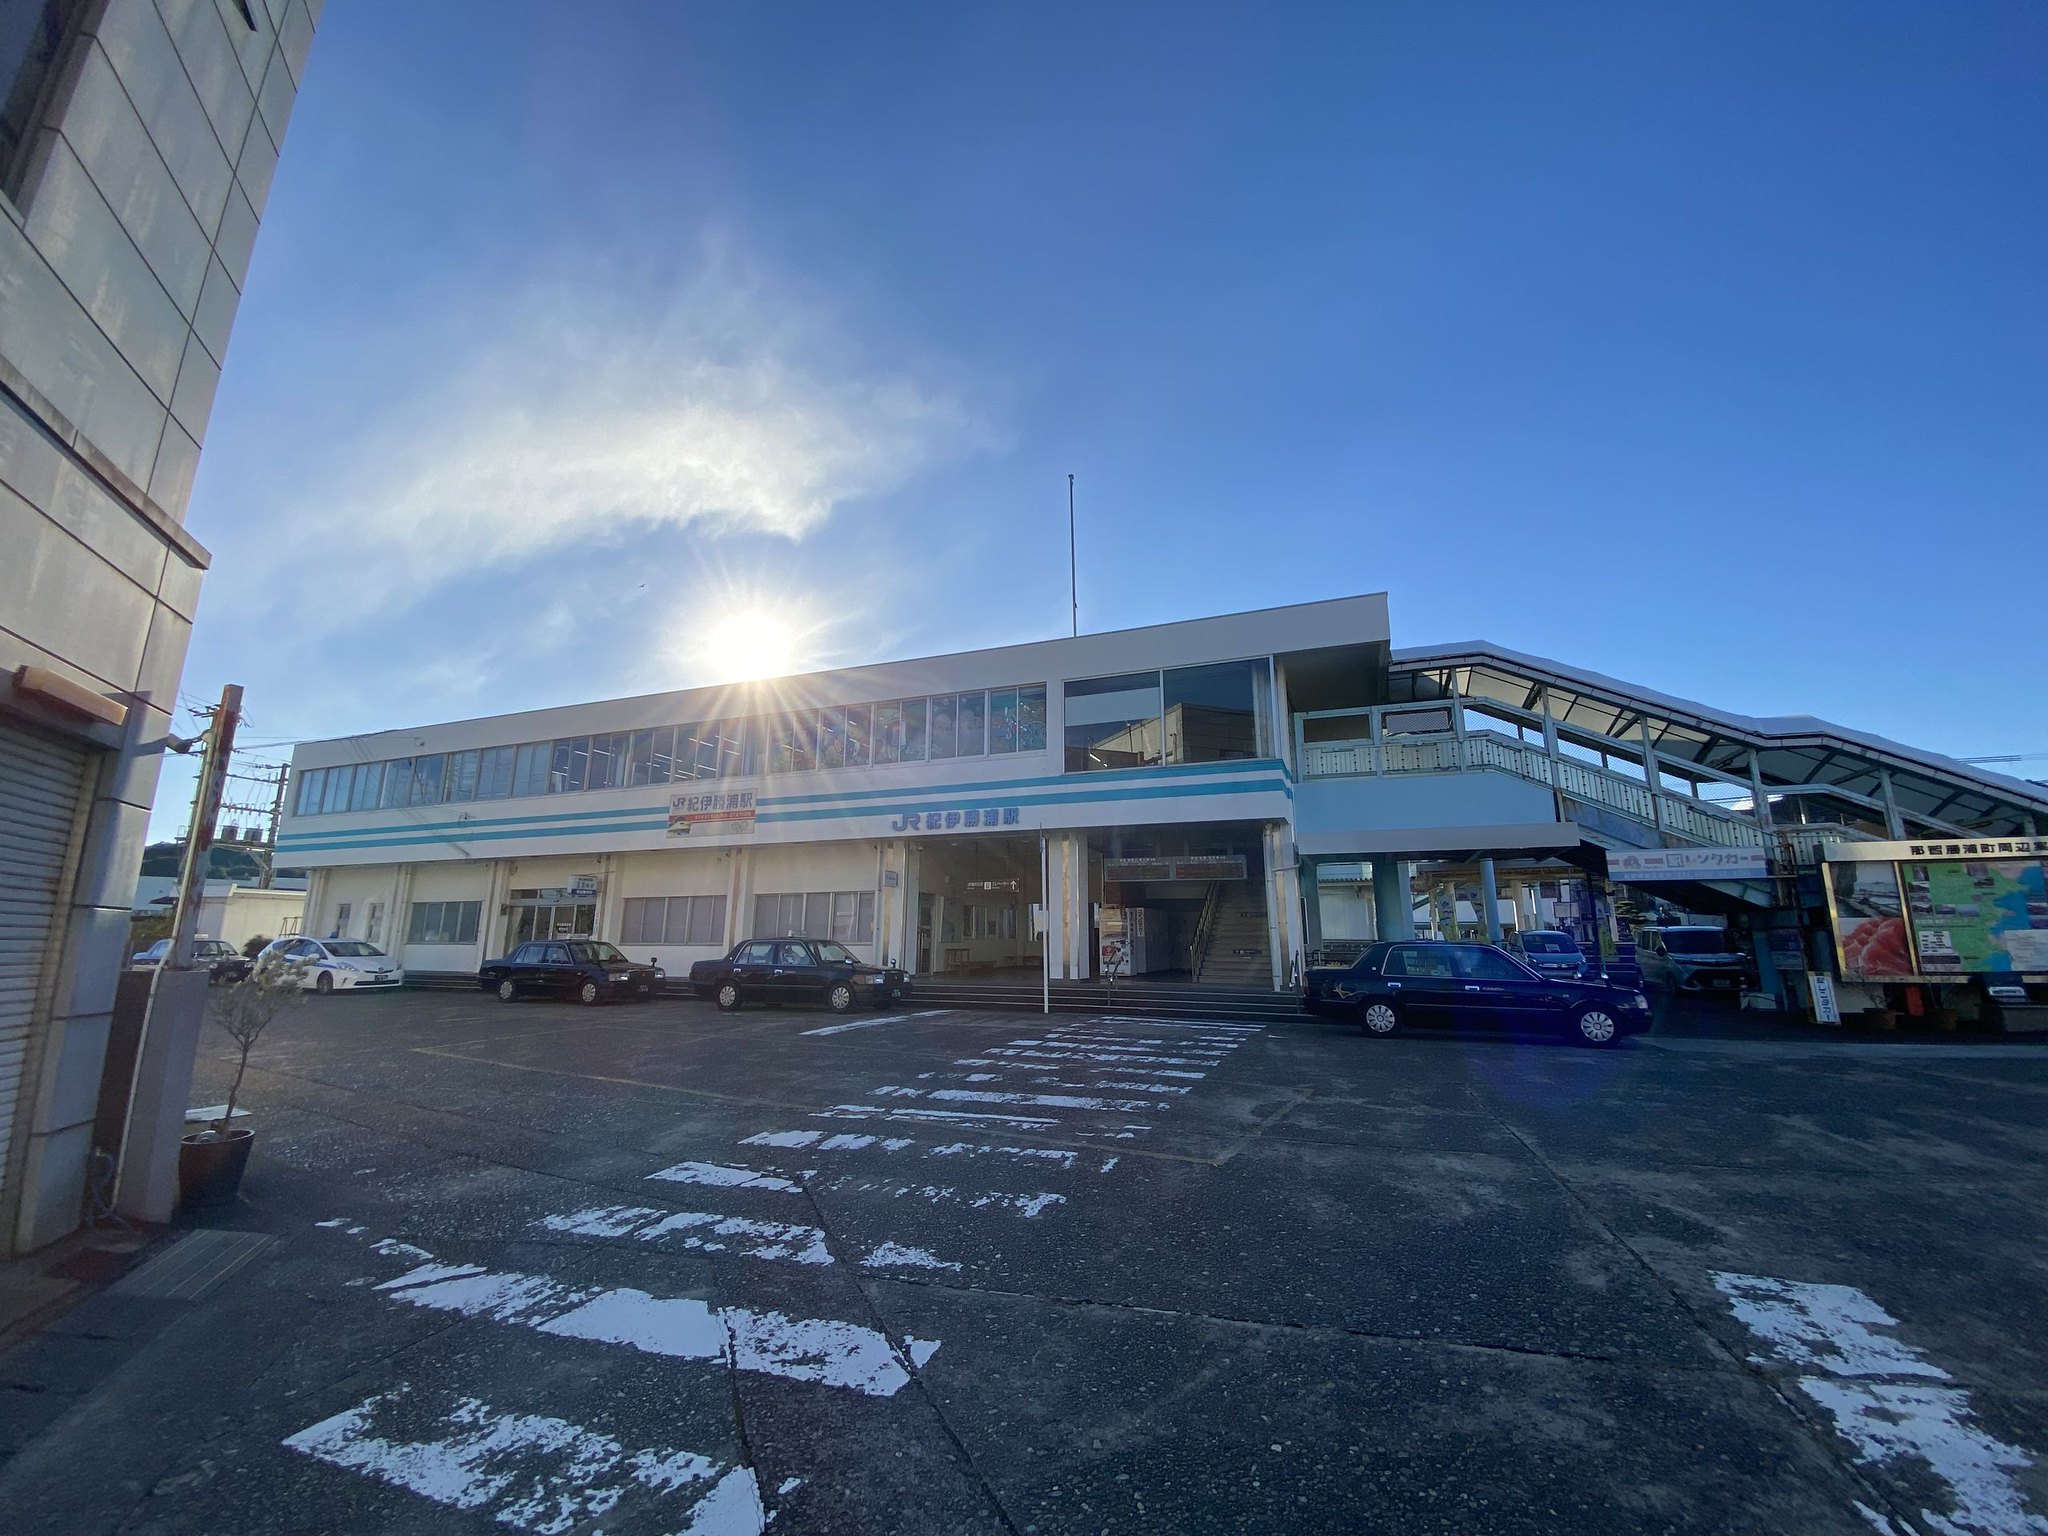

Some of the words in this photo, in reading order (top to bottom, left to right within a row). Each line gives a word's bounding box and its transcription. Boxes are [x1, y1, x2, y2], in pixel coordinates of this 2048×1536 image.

[891, 807, 1020, 831] JR紀伊勝浦駅
